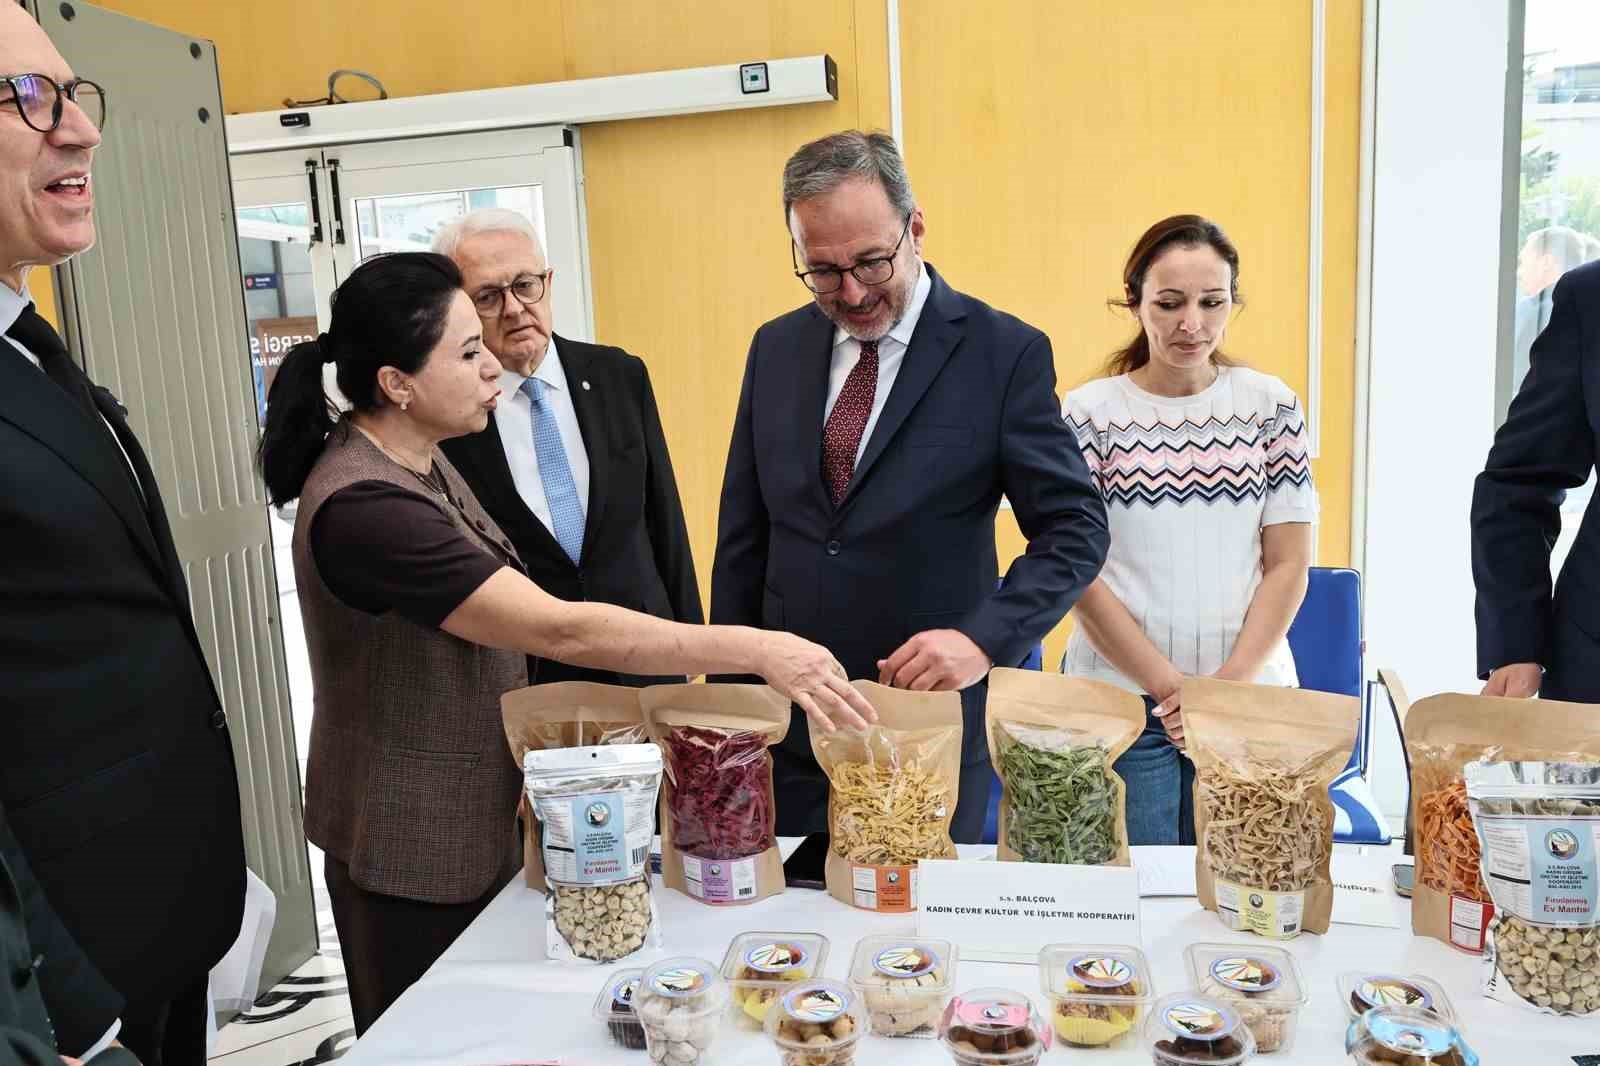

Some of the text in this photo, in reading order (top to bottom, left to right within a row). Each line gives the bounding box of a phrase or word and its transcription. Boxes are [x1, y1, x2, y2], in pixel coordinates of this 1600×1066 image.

[1016, 895, 1055, 904] BALÇOVA
[926, 905, 952, 913] KADIN
[954, 906, 982, 915] ÇEVRE
[1023, 909, 1035, 917] VE
[1037, 909, 1075, 919] İŞLETME
[1077, 911, 1135, 921] KOOPERATİFİ
